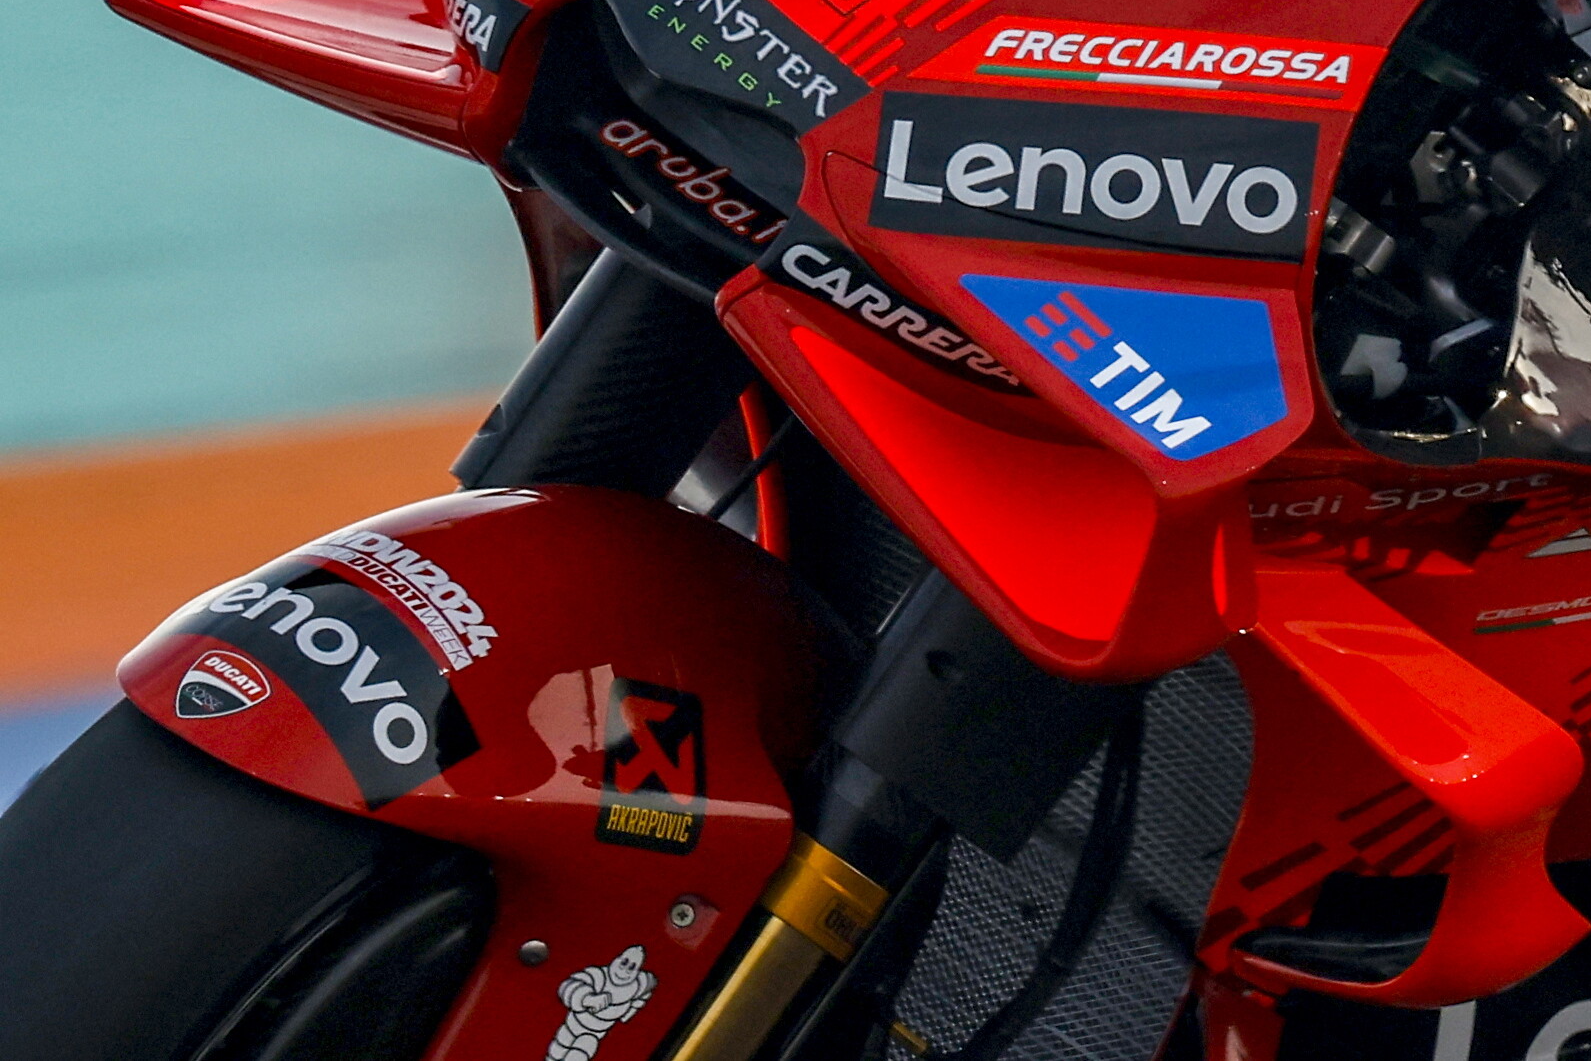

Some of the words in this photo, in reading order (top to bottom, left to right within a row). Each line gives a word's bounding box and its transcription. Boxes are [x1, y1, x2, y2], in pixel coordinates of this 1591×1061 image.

[647, 3, 782, 108] ENERGY
[983, 27, 1352, 85] FRECCIAROSSA
[600, 119, 790, 245] aruba.i
[883, 119, 1299, 234] Lenovo
[1088, 340, 1212, 450] TIM
[1248, 494, 1345, 519] udi
[1364, 472, 1554, 511] Sport
[203, 656, 263, 696] DUCATI
[208, 581, 430, 765] enovo
